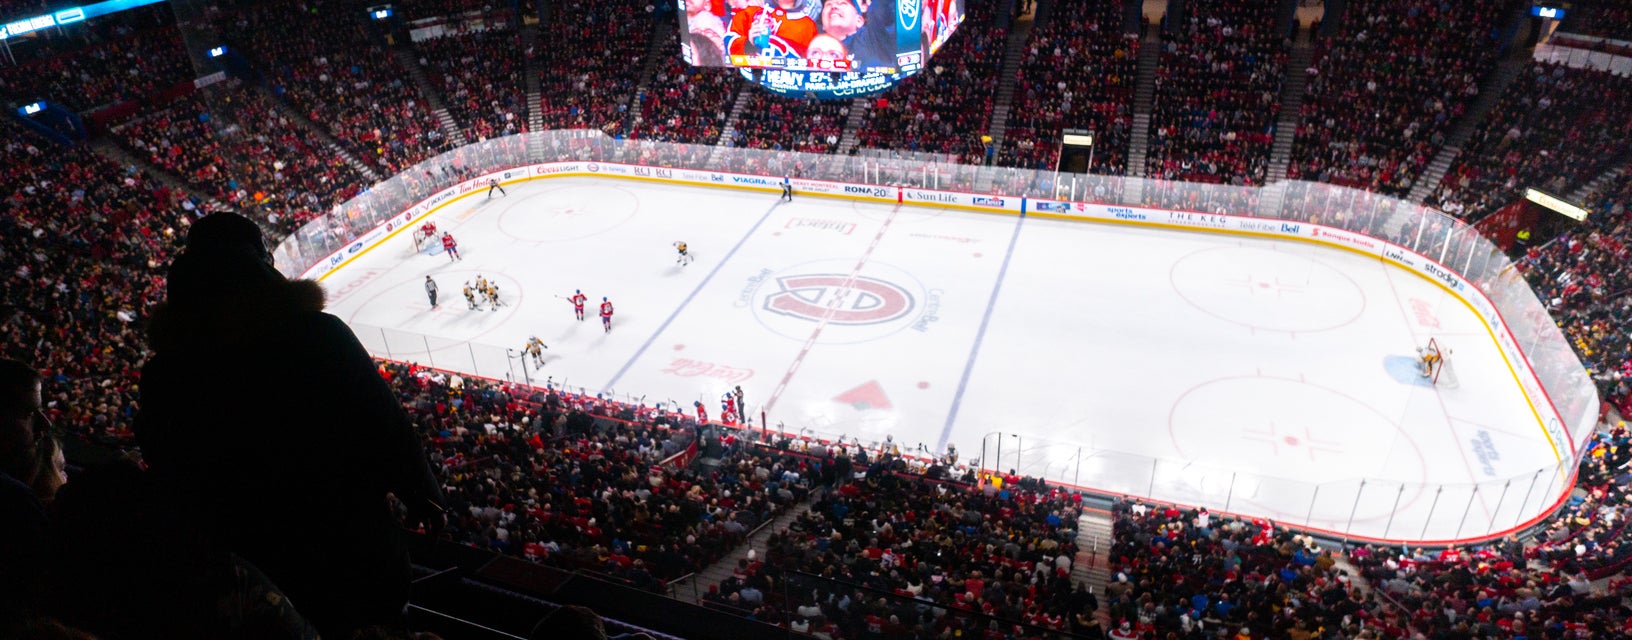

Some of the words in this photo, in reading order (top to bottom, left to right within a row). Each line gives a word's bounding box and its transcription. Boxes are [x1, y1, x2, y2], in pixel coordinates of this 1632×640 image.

[767, 70, 804, 86] HEAVY
[711, 173, 724, 182] Bell
[459, 185, 471, 194] Tim
[844, 185, 873, 194] RONA
[873, 188, 886, 198] 20
[917, 191, 936, 201] Sun
[938, 193, 958, 203] Life
[411, 208, 420, 217] LG
[1107, 207, 1132, 215] sports
[1116, 212, 1146, 220] experts
[1170, 212, 1193, 220] THE
[1201, 215, 1226, 223] KEG
[393, 218, 402, 228] LG
[1281, 223, 1299, 233] Bell
[1352, 237, 1375, 249] Scotia
[331, 253, 343, 265] Bell
